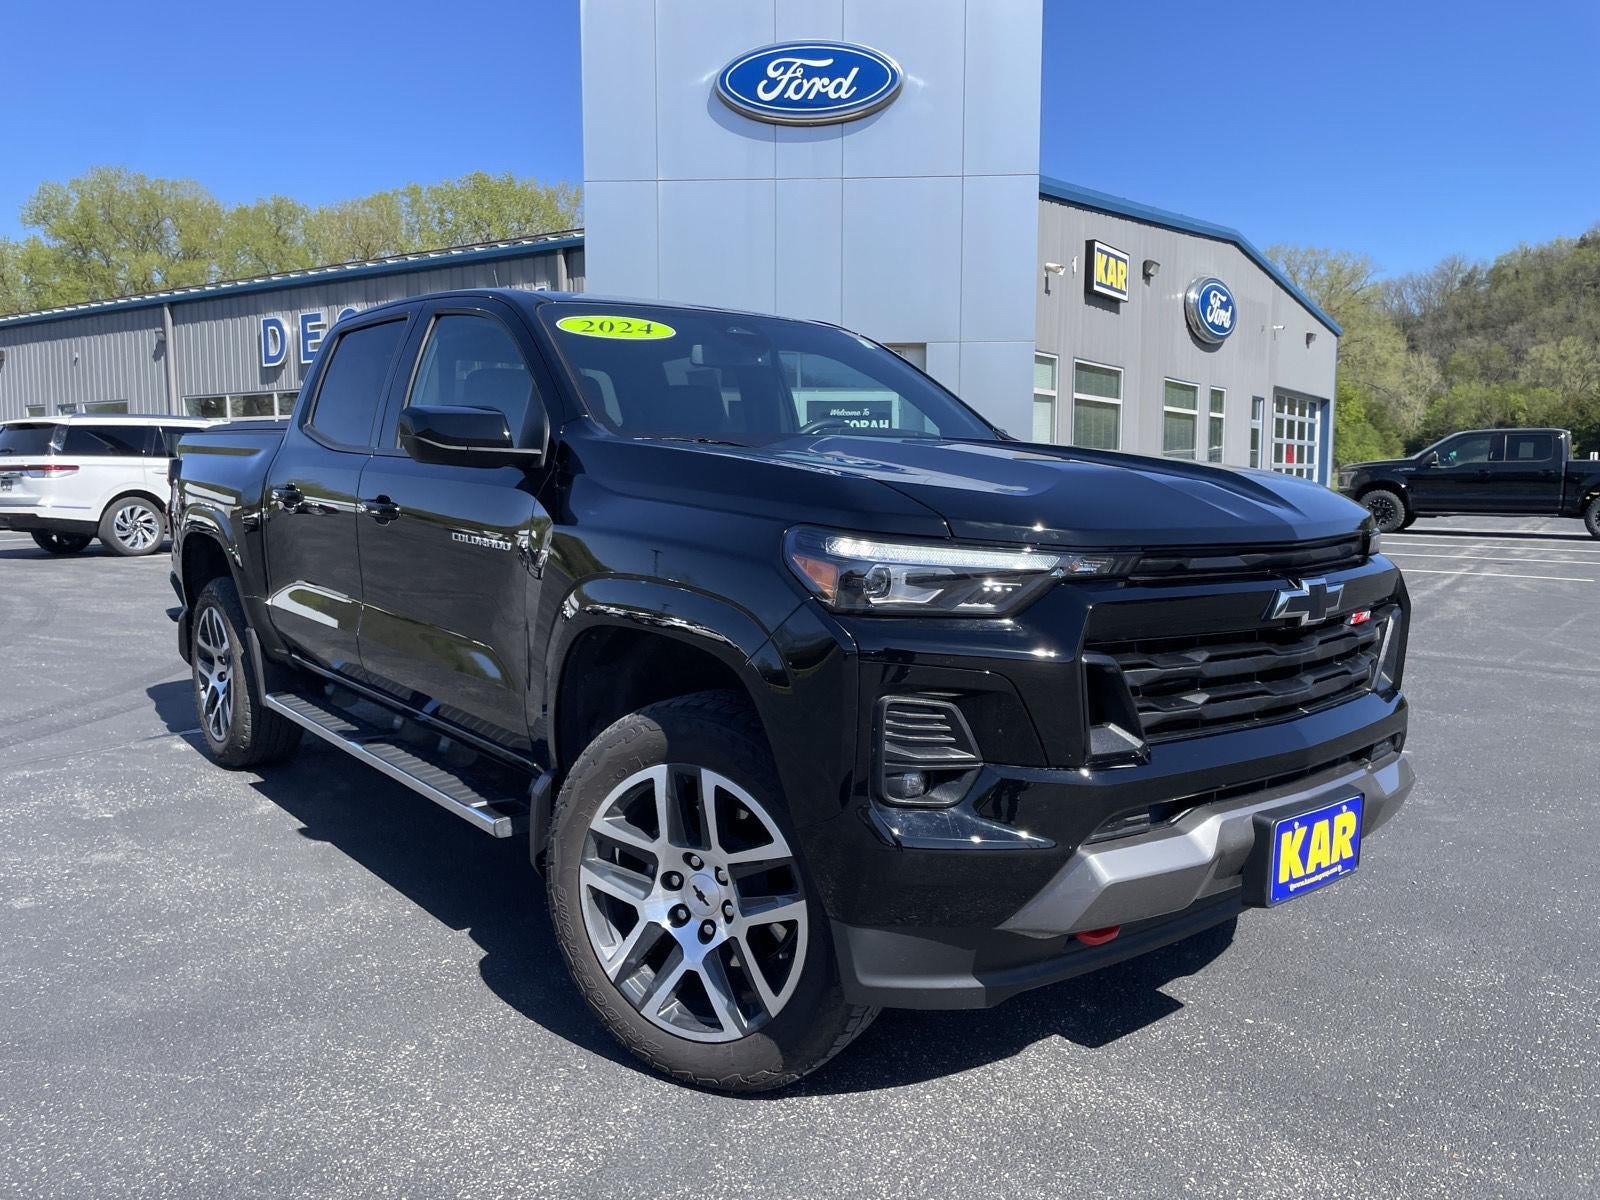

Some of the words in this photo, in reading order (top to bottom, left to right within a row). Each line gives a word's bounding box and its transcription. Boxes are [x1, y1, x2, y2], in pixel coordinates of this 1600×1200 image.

[757, 57, 860, 101] Ford
[1096, 251, 1127, 291] KAR
[580, 320, 653, 334] 2024
[1206, 290, 1233, 328] Ford
[829, 408, 861, 417] Welcome
[862, 408, 870, 416] To
[451, 532, 512, 551] COLORADO
[1278, 811, 1357, 884] KAR
